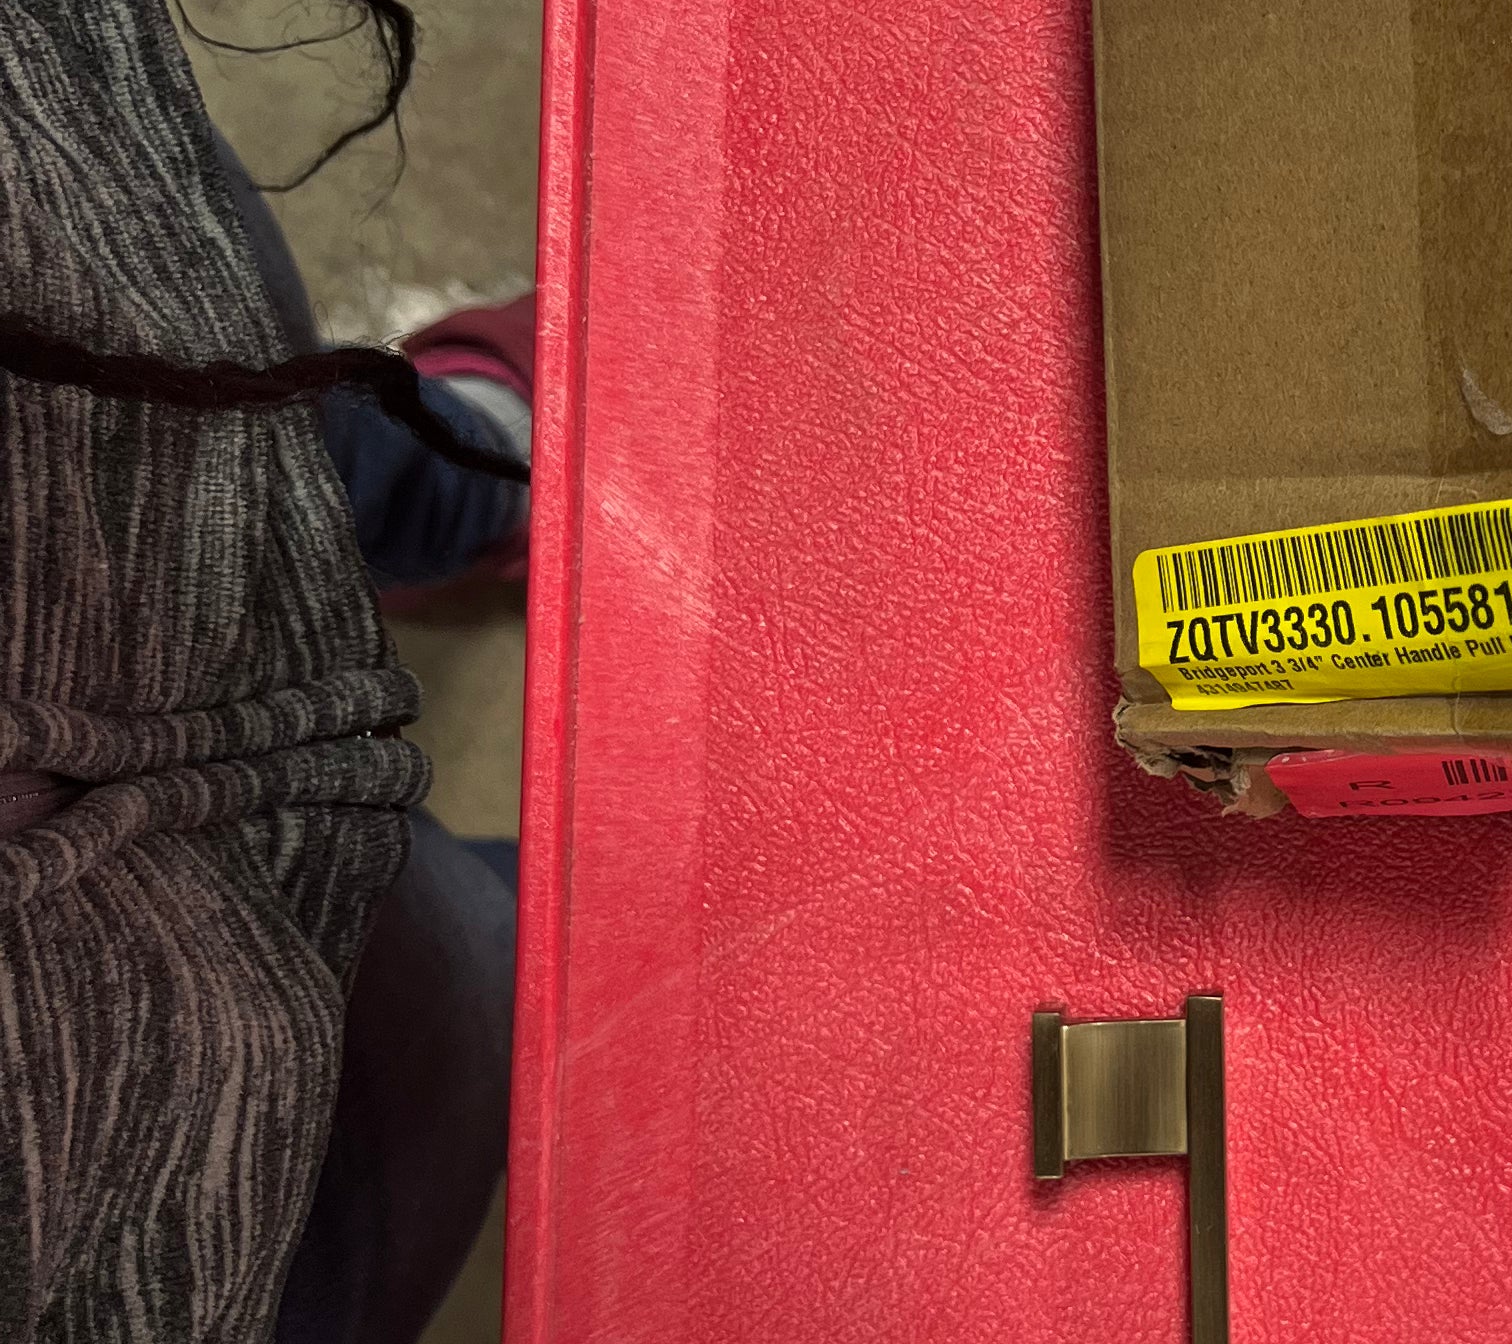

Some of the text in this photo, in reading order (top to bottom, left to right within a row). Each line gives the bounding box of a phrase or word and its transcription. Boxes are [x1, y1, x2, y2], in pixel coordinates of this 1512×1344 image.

[1177, 659, 1270, 682] Bridgeport
[1270, 659, 1286, 675] 3
[1332, 650, 1392, 670] Center
[1394, 642, 1462, 665] Handle
[1465, 637, 1507, 658] Pull
